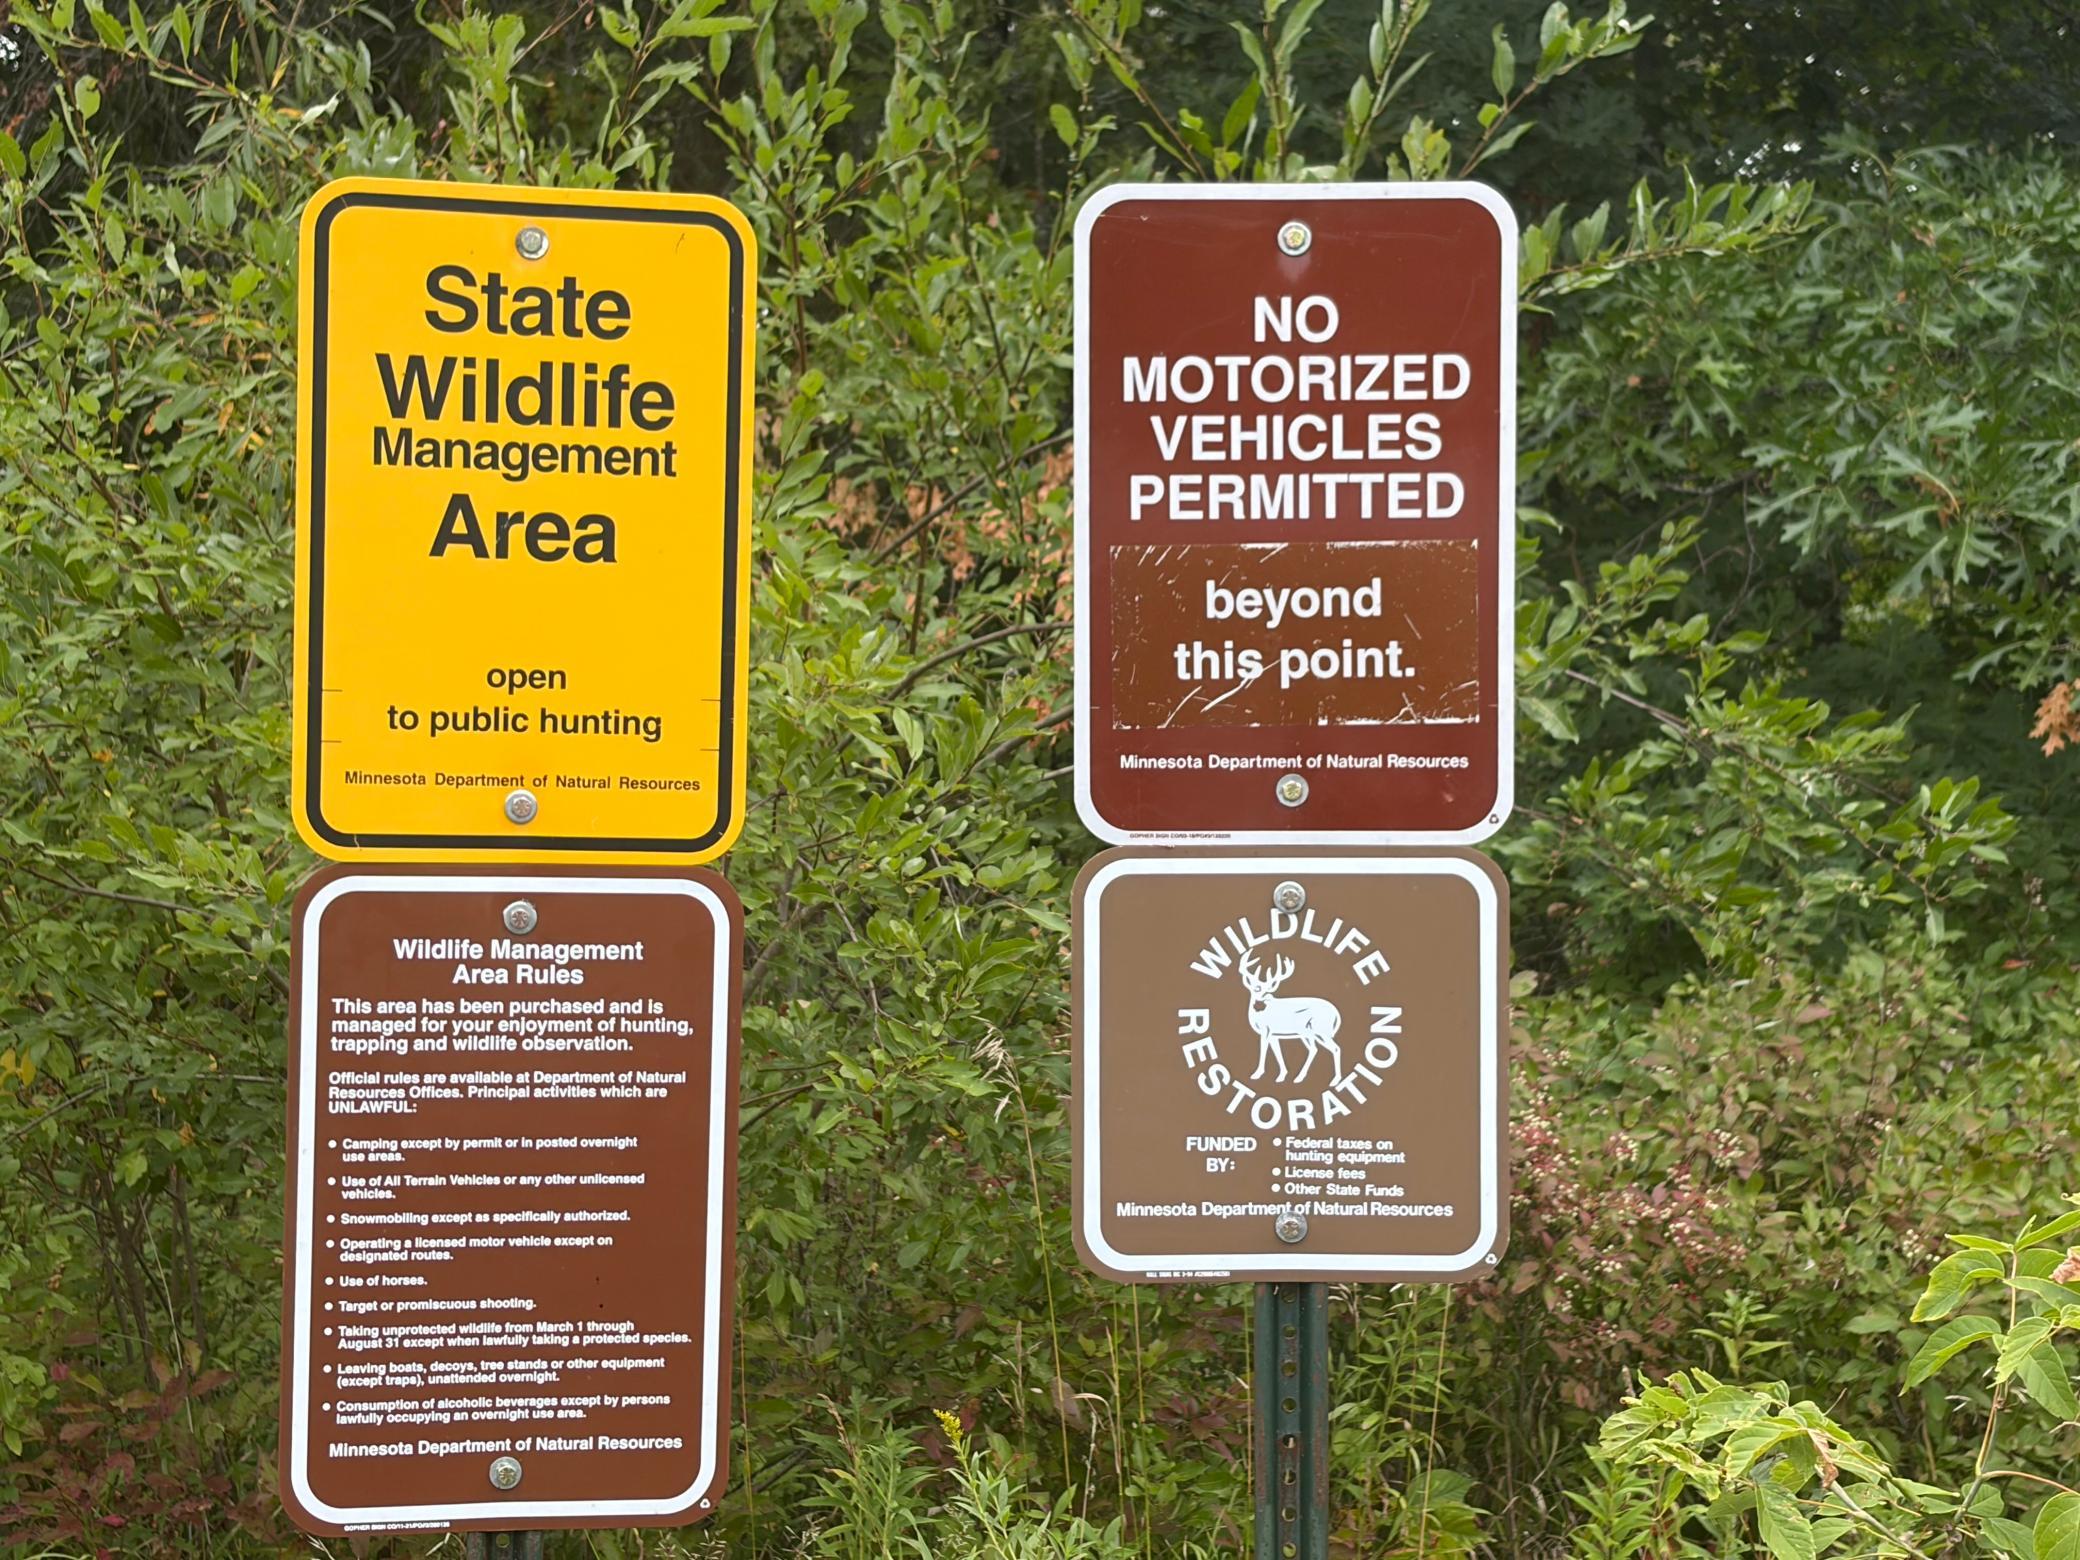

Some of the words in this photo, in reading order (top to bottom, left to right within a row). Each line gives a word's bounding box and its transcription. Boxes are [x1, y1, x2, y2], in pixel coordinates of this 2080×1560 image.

[424, 265, 630, 340] State
[1252, 295, 1340, 342] NO
[1123, 354, 1470, 402] MOTORIZED
[375, 353, 674, 430] Wildlife
[1150, 414, 1442, 460] VEHICLES
[373, 427, 677, 480] Management
[1130, 473, 1464, 519] PERMITTED
[429, 494, 616, 562] Area
[1206, 578, 1381, 627] beyond
[1173, 640, 1263, 680] this
[1280, 639, 1416, 689] point.
[486, 668, 566, 694] open
[387, 705, 418, 730] to
[430, 706, 528, 736] public
[540, 708, 661, 742] hunting
[1120, 754, 1202, 768] Minnesota
[1208, 754, 1302, 770] Department
[1306, 754, 1322, 768] of
[1326, 754, 1382, 768] Natural
[1387, 753, 1469, 768] Resources
[345, 771, 426, 785] Minnesota
[434, 772, 524, 788] Department
[532, 774, 547, 787] of
[556, 775, 610, 788] Natural
[619, 776, 700, 790] Resources
[393, 938, 483, 959] Wildlife
[490, 939, 644, 963] Management
[1190, 908, 1391, 985] WILDLIFE
[452, 964, 508, 984] Area
[516, 963, 584, 984] Rules
[331, 998, 372, 1014] This
[376, 1001, 416, 1014] area
[421, 998, 454, 1014] has
[460, 998, 504, 1013] been
[509, 998, 604, 1016] purchased
[609, 999, 642, 1014] and
[648, 998, 663, 1014] is
[331, 1018, 416, 1036] managed
[420, 1017, 447, 1031] for
[451, 1019, 494, 1037] your
[498, 1018, 592, 1037] enjoyment
[597, 1017, 616, 1032] of
[620, 1018, 693, 1036] hunting,
[330, 1036, 408, 1054] trapping
[412, 1036, 447, 1051] and
[452, 1036, 517, 1050] wildlife
[521, 1036, 633, 1050] observation.
[1178, 1006, 1402, 1131] RESTORATION
[328, 1072, 380, 1084] Official
[383, 1072, 420, 1084] rules
[423, 1073, 446, 1084] are
[449, 1071, 513, 1083] available
[516, 1071, 530, 1083] at
[533, 1071, 615, 1085] Department
[618, 1071, 633, 1083] of
[636, 1071, 686, 1083] Natural
[328, 1086, 406, 1099] Resources
[408, 1086, 464, 1098] Offices.
[468, 1085, 530, 1099] Principal
[533, 1085, 596, 1097] activities
[600, 1085, 642, 1097] which
[645, 1087, 668, 1097] are
[328, 1100, 417, 1113] UNLAWFUL:
[342, 1138, 398, 1151] Camping
[400, 1138, 442, 1150] except
[444, 1137, 460, 1151] by
[462, 1137, 502, 1150] permit
[504, 1139, 518, 1148] or
[521, 1136, 533, 1147] in
[535, 1137, 577, 1149] posted
[580, 1136, 638, 1149] overnight
[1186, 1136, 1257, 1151] FUNDED
[1285, 1136, 1333, 1152] Federal
[1336, 1138, 1372, 1150] taxes
[1376, 1140, 1393, 1150] on
[342, 1152, 365, 1162] use
[367, 1152, 405, 1161] areas.
[1206, 1157, 1235, 1172] BY:
[1285, 1149, 1333, 1164] hunting
[1337, 1151, 1405, 1164] equipment
[341, 1175, 366, 1187] Use
[368, 1175, 382, 1189] of
[383, 1175, 401, 1186] All
[403, 1175, 446, 1186] Terrain
[449, 1174, 500, 1185] Vehicles
[503, 1176, 517, 1185] or
[519, 1175, 542, 1187] any
[544, 1174, 577, 1184] other
[579, 1173, 645, 1184] unlicensed
[1284, 1166, 1334, 1179] License
[1337, 1167, 1366, 1179] fees
[341, 1188, 396, 1199] vehicles.
[1284, 1182, 1321, 1195] Other
[1326, 1183, 1360, 1195] State
[1364, 1184, 1404, 1197] Funds
[1116, 1202, 1196, 1216] Minnesota
[1201, 1201, 1291, 1220] Department
[1295, 1201, 1311, 1215] of
[1314, 1201, 1368, 1216] Natural
[1370, 1201, 1453, 1216] Resources
[340, 1238, 401, 1251] Operating
[404, 1239, 412, 1248] a
[414, 1236, 466, 1248] licensed
[468, 1236, 506, 1247] motor
[508, 1235, 551, 1246] vehicle
[553, 1235, 594, 1248] except
[596, 1236, 613, 1245] on
[339, 1250, 408, 1263] designated
[410, 1250, 453, 1260] routes.
[339, 1275, 364, 1287] Use
[366, 1275, 379, 1286] of
[382, 1275, 428, 1286] horses.
[338, 1300, 378, 1314] Target
[380, 1301, 394, 1311] or
[396, 1299, 477, 1312] promiscuous
[479, 1297, 536, 1310] shooting.
[338, 1325, 379, 1338] Taking
[382, 1324, 456, 1337] unprotected
[458, 1322, 502, 1336] wildlife
[504, 1322, 533, 1336] from
[536, 1321, 574, 1335] March
[576, 1321, 582, 1331] 1
[586, 1321, 634, 1335] through
[337, 1336, 382, 1351] August
[385, 1336, 400, 1348] 31
[402, 1336, 444, 1349] except
[446, 1335, 480, 1346] when
[482, 1334, 529, 1347] lawfully
[531, 1333, 570, 1347] taking
[572, 1335, 580, 1344] a
[582, 1332, 640, 1346] protected
[642, 1332, 692, 1345] species.
[336, 1399, 419, 1412] Consumption
[421, 1398, 435, 1412] of
[437, 1397, 492, 1409] alcoholic
[495, 1397, 558, 1410] beverages
[560, 1395, 601, 1407] except
[603, 1395, 619, 1407] by
[621, 1395, 670, 1407] persons
[336, 1412, 384, 1425] lawfully
[386, 1411, 450, 1424] occupying
[453, 1411, 468, 1421] an
[471, 1408, 529, 1421] overnight
[532, 1409, 554, 1418] use
[556, 1409, 586, 1418] area.
[329, 1442, 413, 1457] Minnesota
[418, 1439, 511, 1456] Department
[515, 1438, 532, 1451] of
[536, 1437, 593, 1450] Natural
[598, 1437, 682, 1449] Resources
